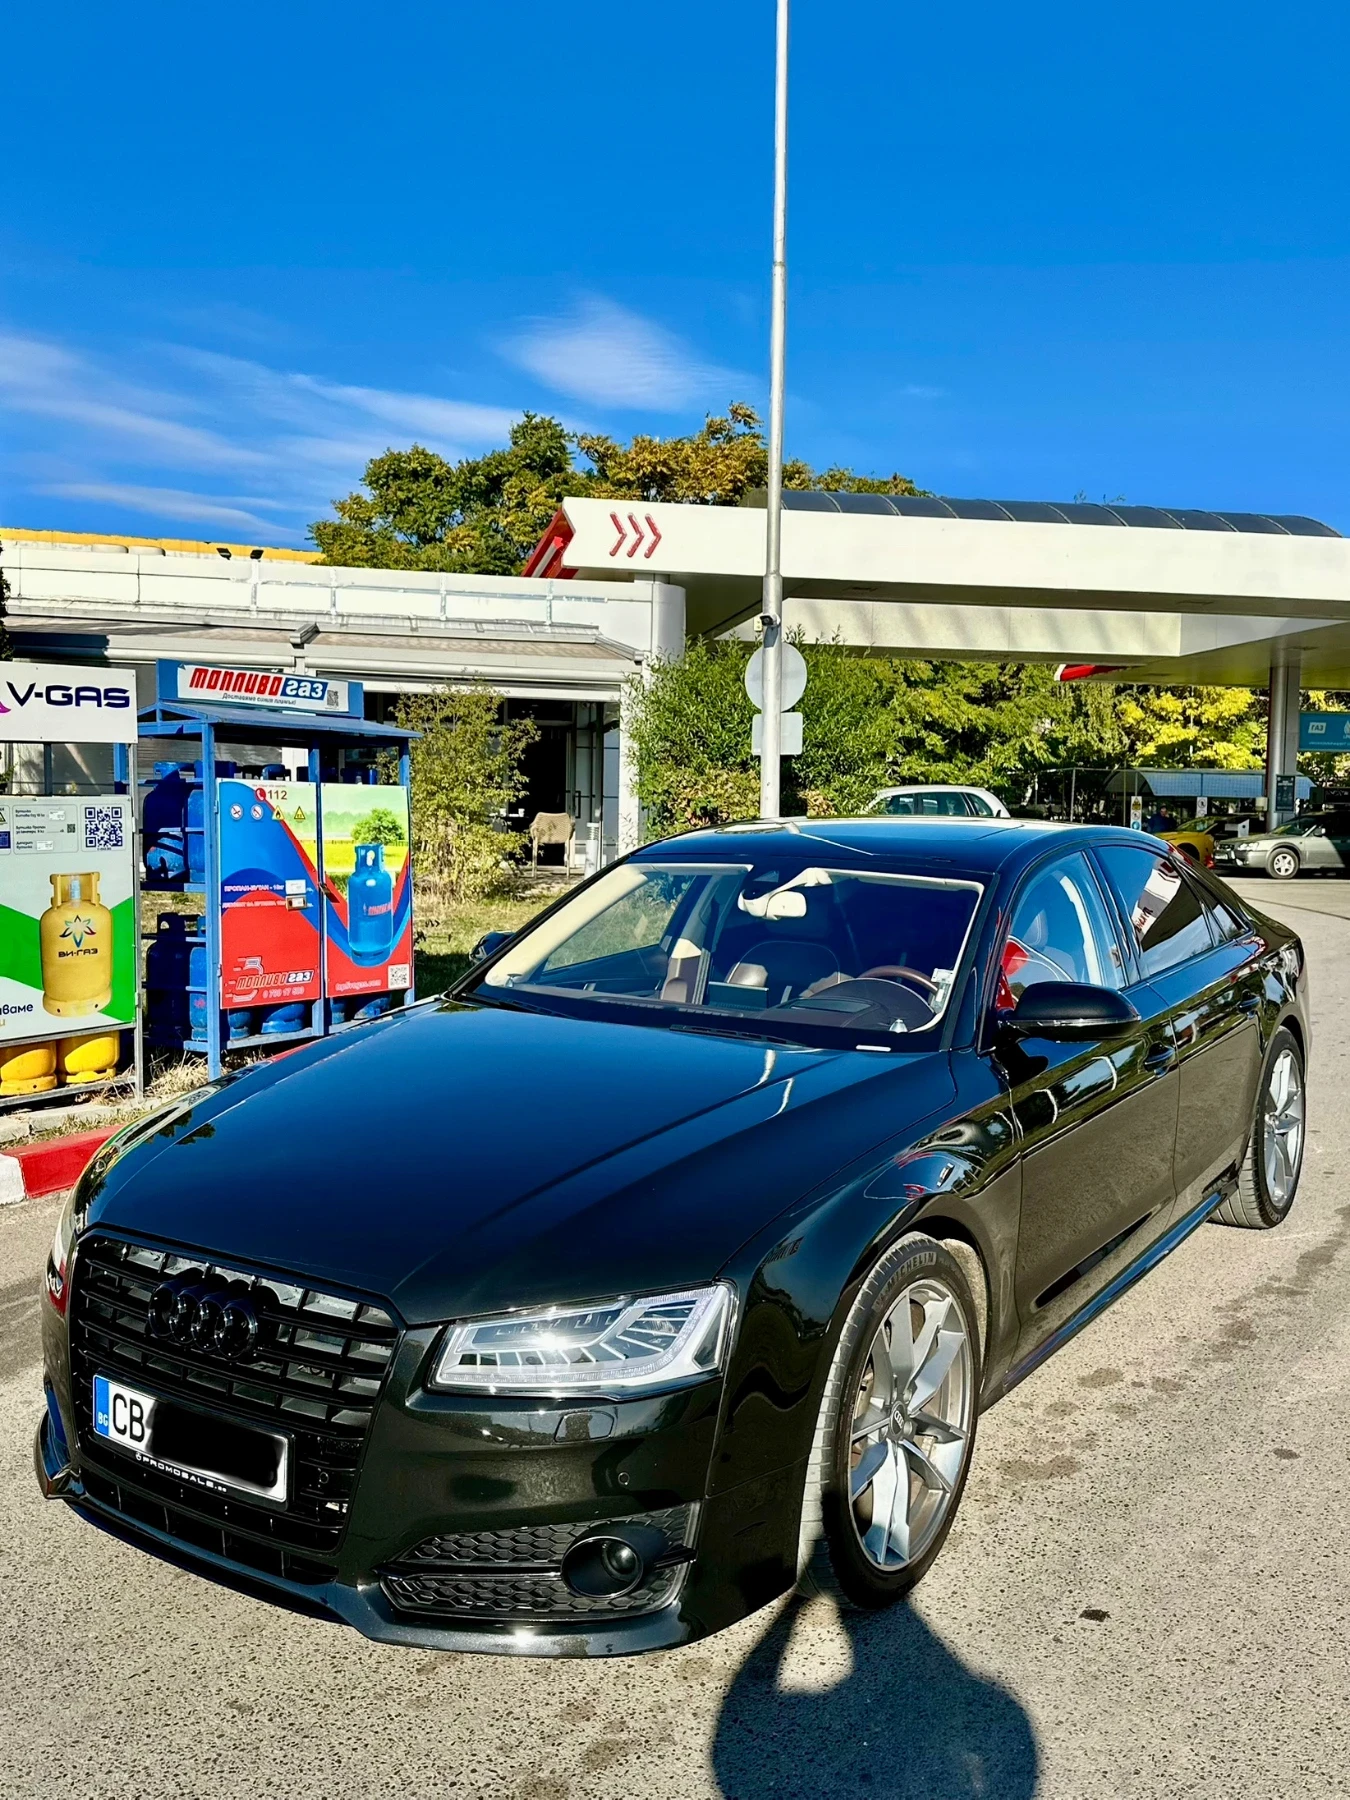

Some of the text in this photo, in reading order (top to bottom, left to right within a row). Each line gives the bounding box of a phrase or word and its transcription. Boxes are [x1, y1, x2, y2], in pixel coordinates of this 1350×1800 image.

[6, 680, 130, 708] V-GAS
[267, 790, 287, 800] 112
[58, 948, 98, 958] ВИ-ГАЗ
[97, 1411, 109, 1426] BG
[112, 1392, 145, 1443] CB
